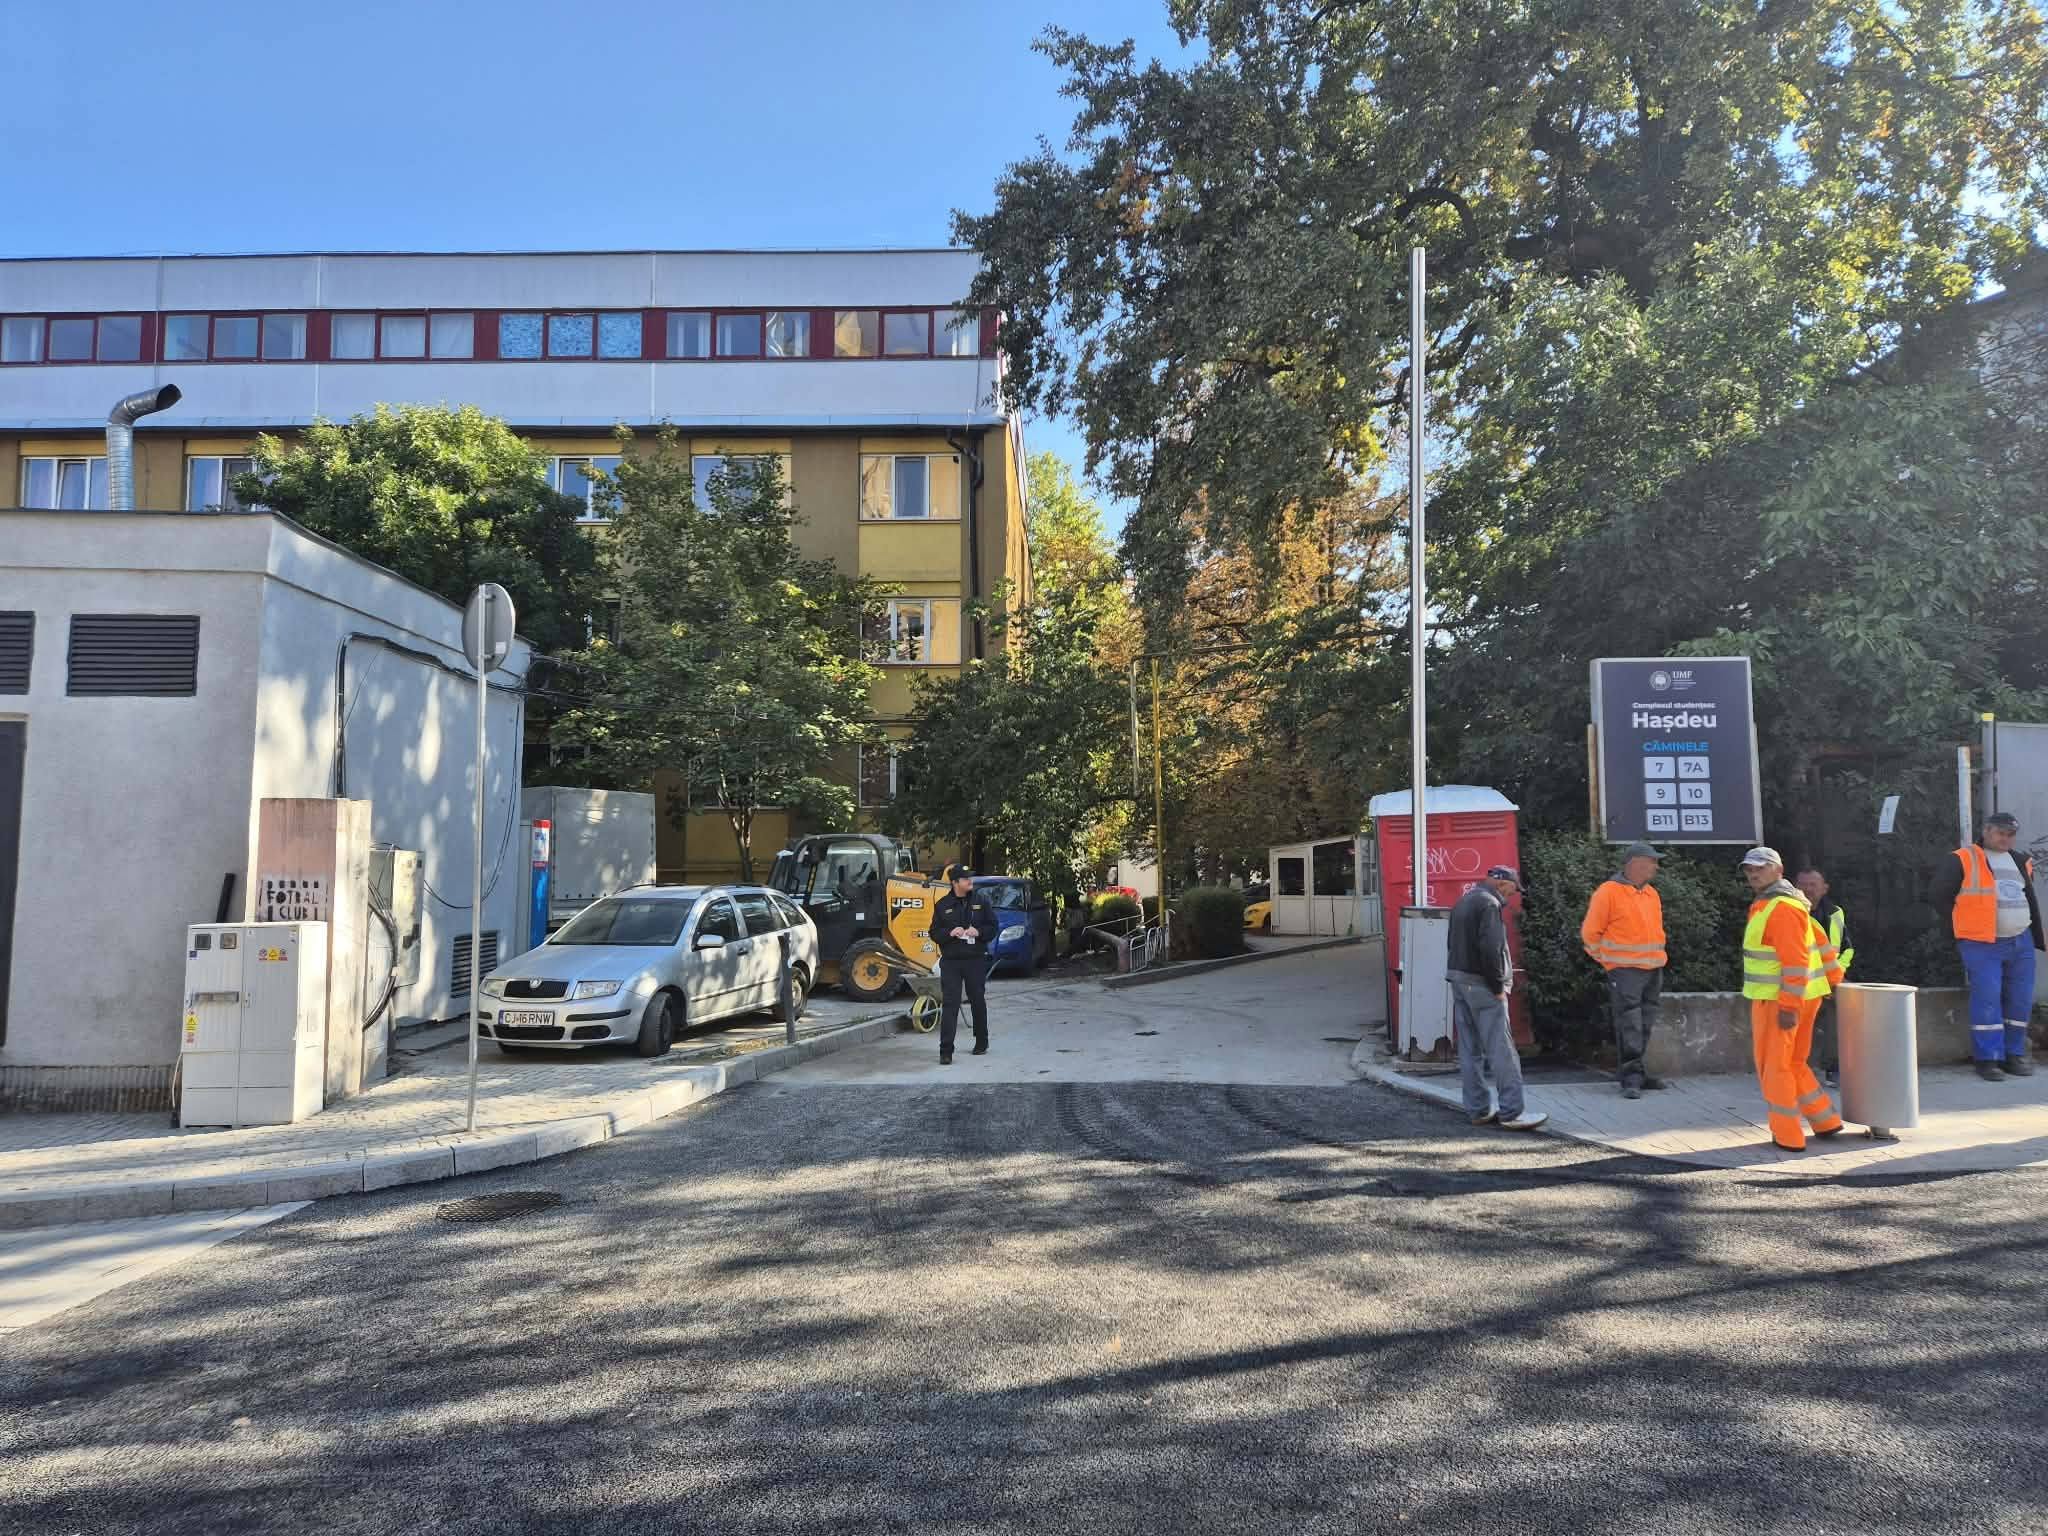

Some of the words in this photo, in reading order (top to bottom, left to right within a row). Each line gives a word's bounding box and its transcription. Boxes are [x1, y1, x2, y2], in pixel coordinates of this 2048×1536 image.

[1632, 711, 1717, 733] Hașdeu
[1656, 762, 1664, 773] 7
[1684, 762, 1703, 773] 7A
[1656, 789, 1665, 799] 9
[1688, 789, 1703, 799] 10
[1653, 815, 1673, 825] B11
[1685, 815, 1709, 825] B13
[267, 890, 319, 904] FOTBAL
[892, 898, 923, 908] JCB
[280, 906, 308, 920] CLUB
